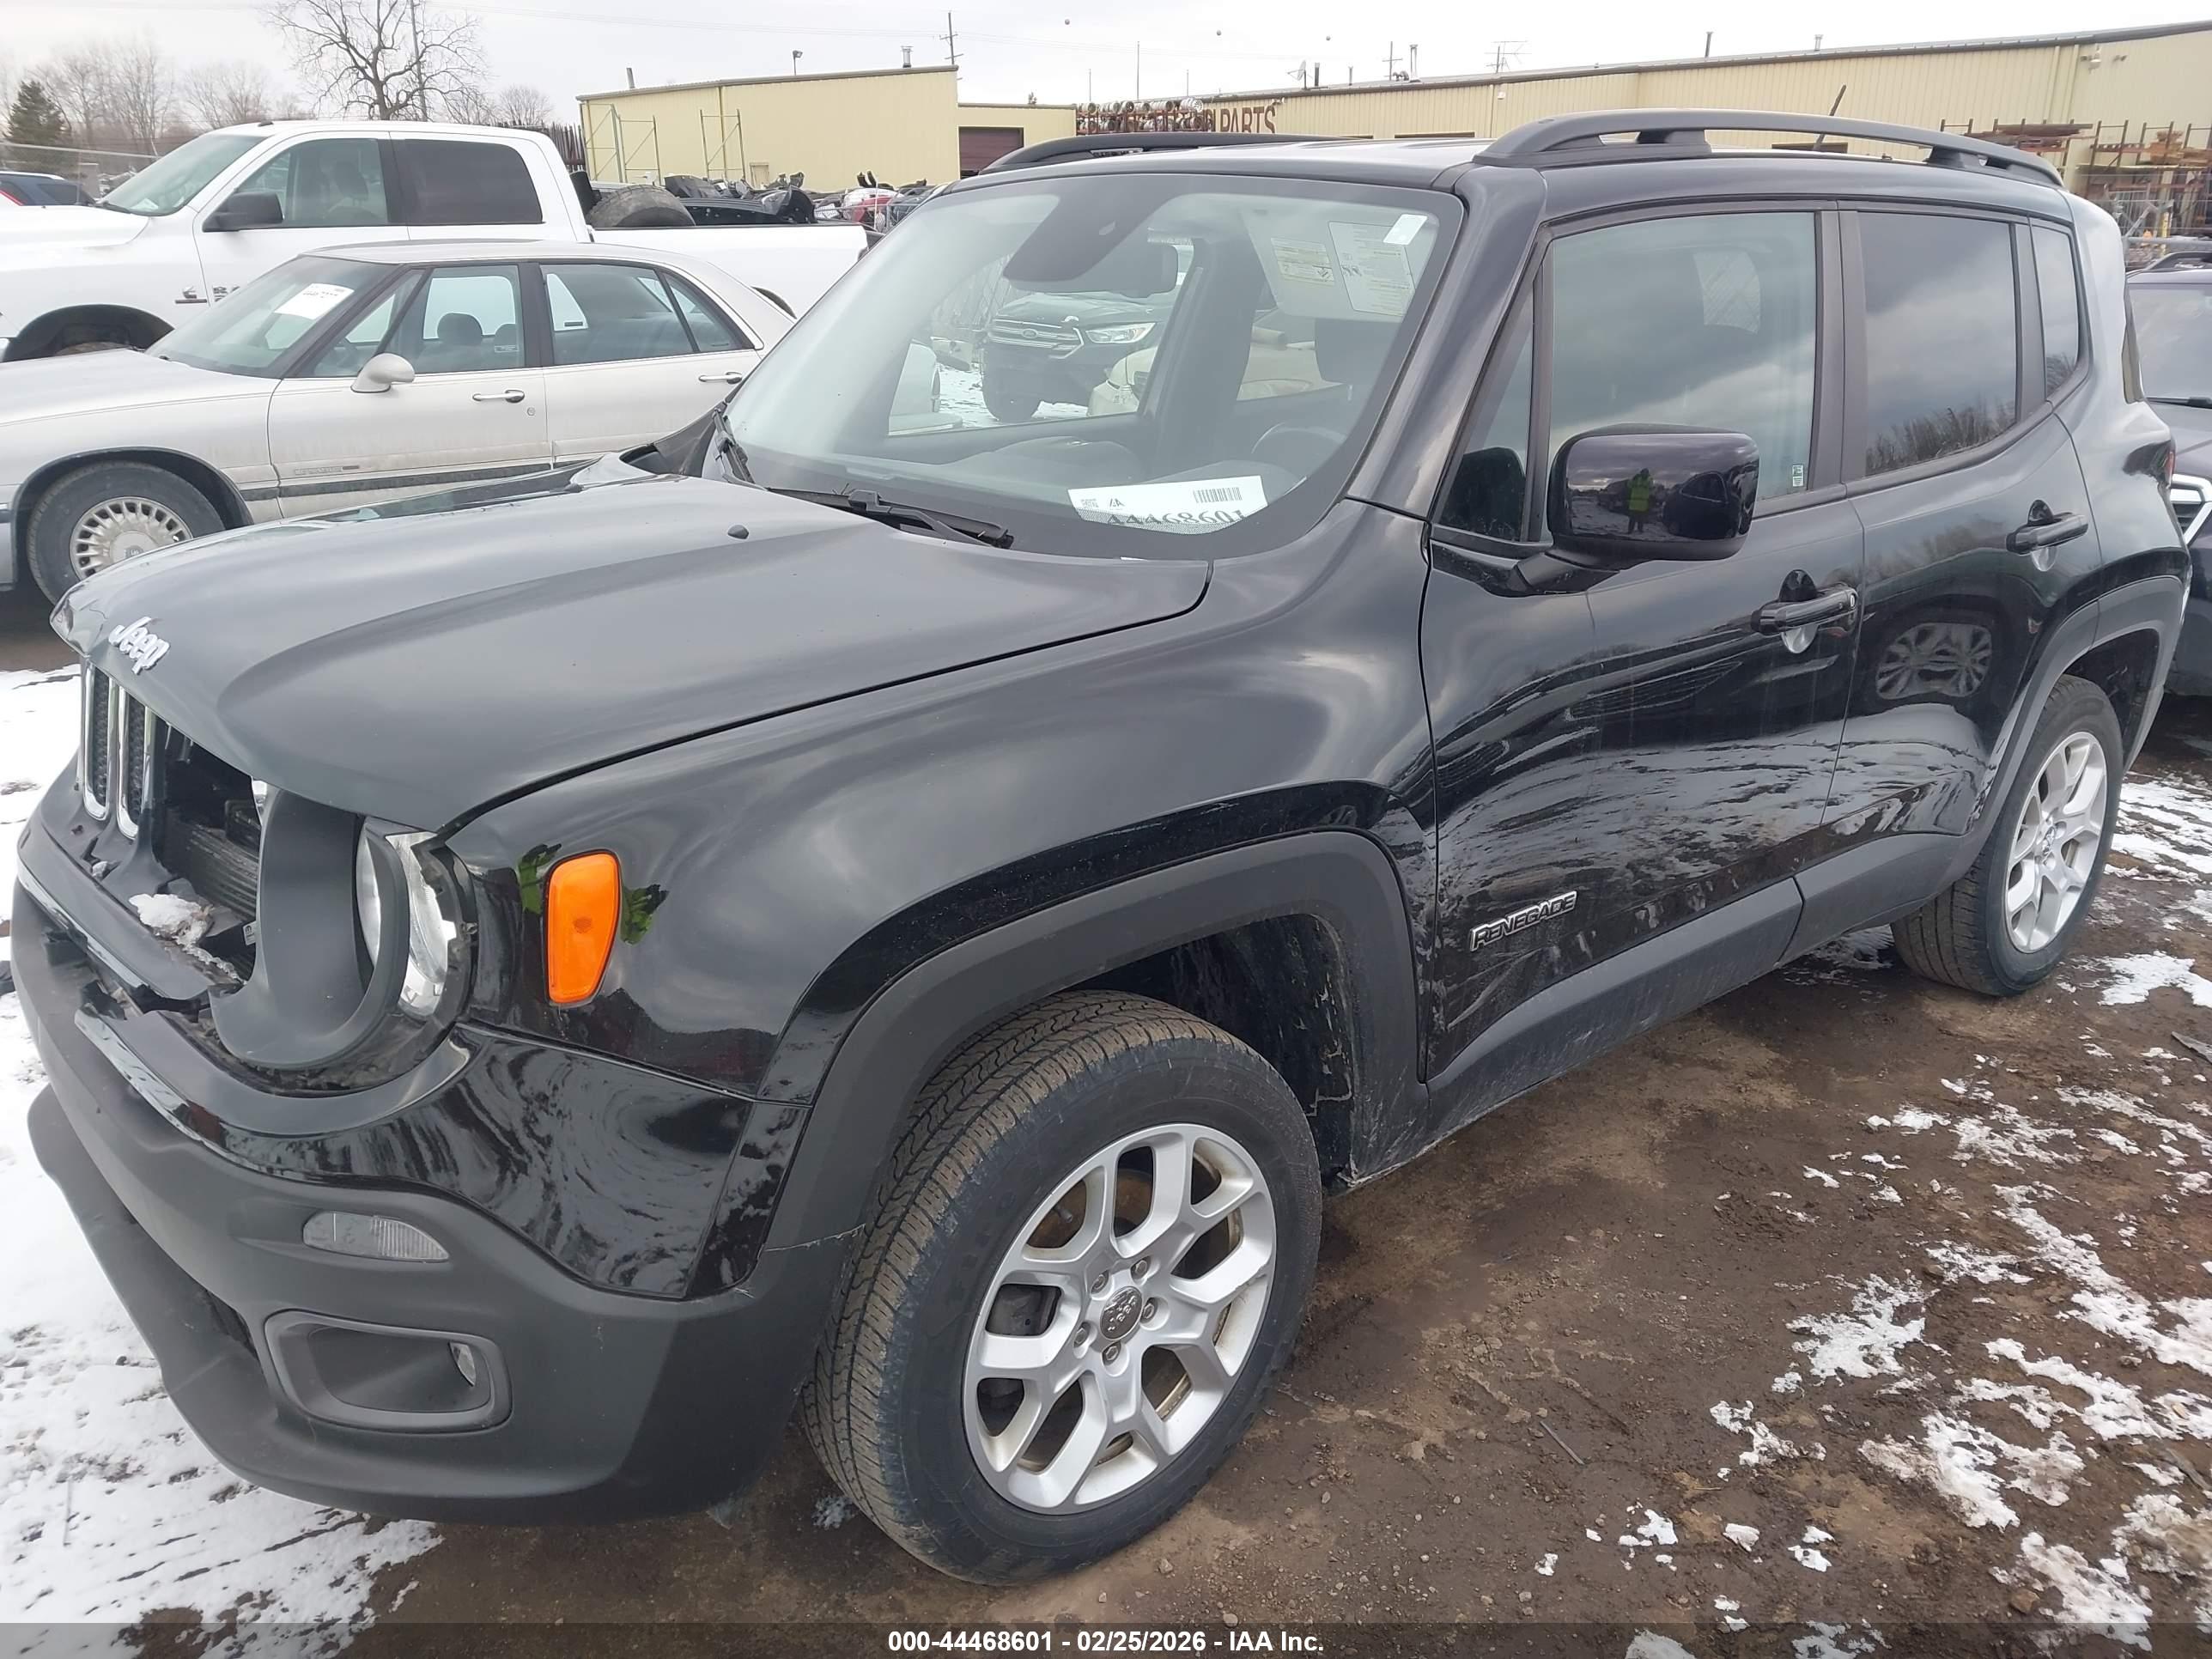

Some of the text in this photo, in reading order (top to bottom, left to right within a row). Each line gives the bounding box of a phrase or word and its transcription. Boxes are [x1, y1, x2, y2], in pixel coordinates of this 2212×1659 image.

[1220, 106, 1276, 133] PARTS
[108, 617, 171, 675] Jeep
[1471, 891, 1577, 951] RENEGADE
